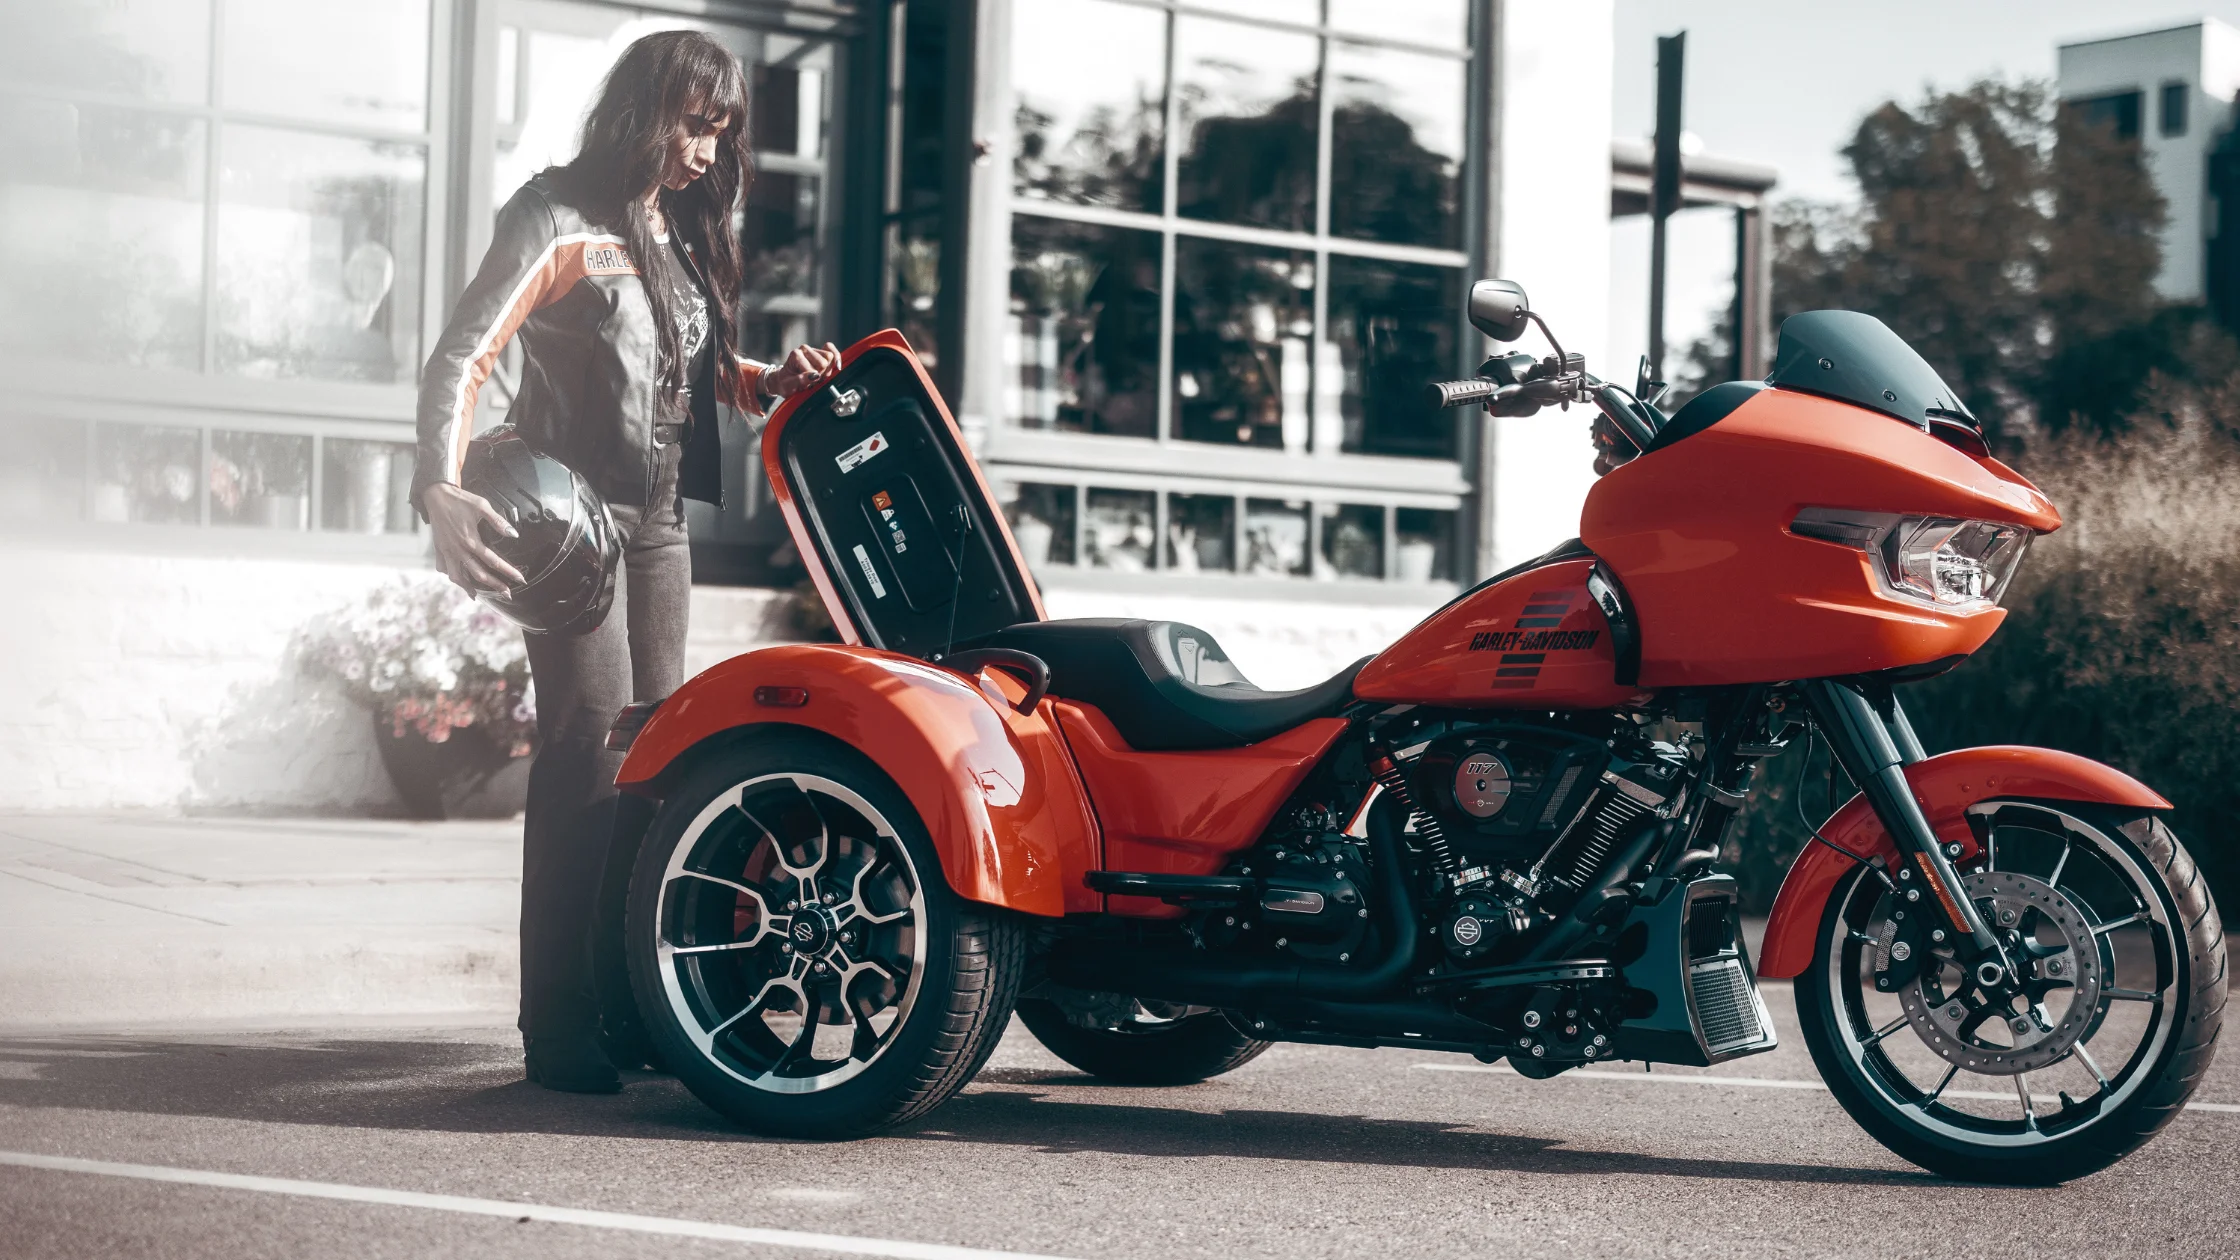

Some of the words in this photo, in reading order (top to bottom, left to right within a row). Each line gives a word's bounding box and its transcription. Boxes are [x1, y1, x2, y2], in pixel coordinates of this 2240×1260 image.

[586, 248, 632, 270] HARLE
[1469, 630, 1600, 651] HARLEY-DAVIDSON
[1466, 762, 1498, 775] 117
